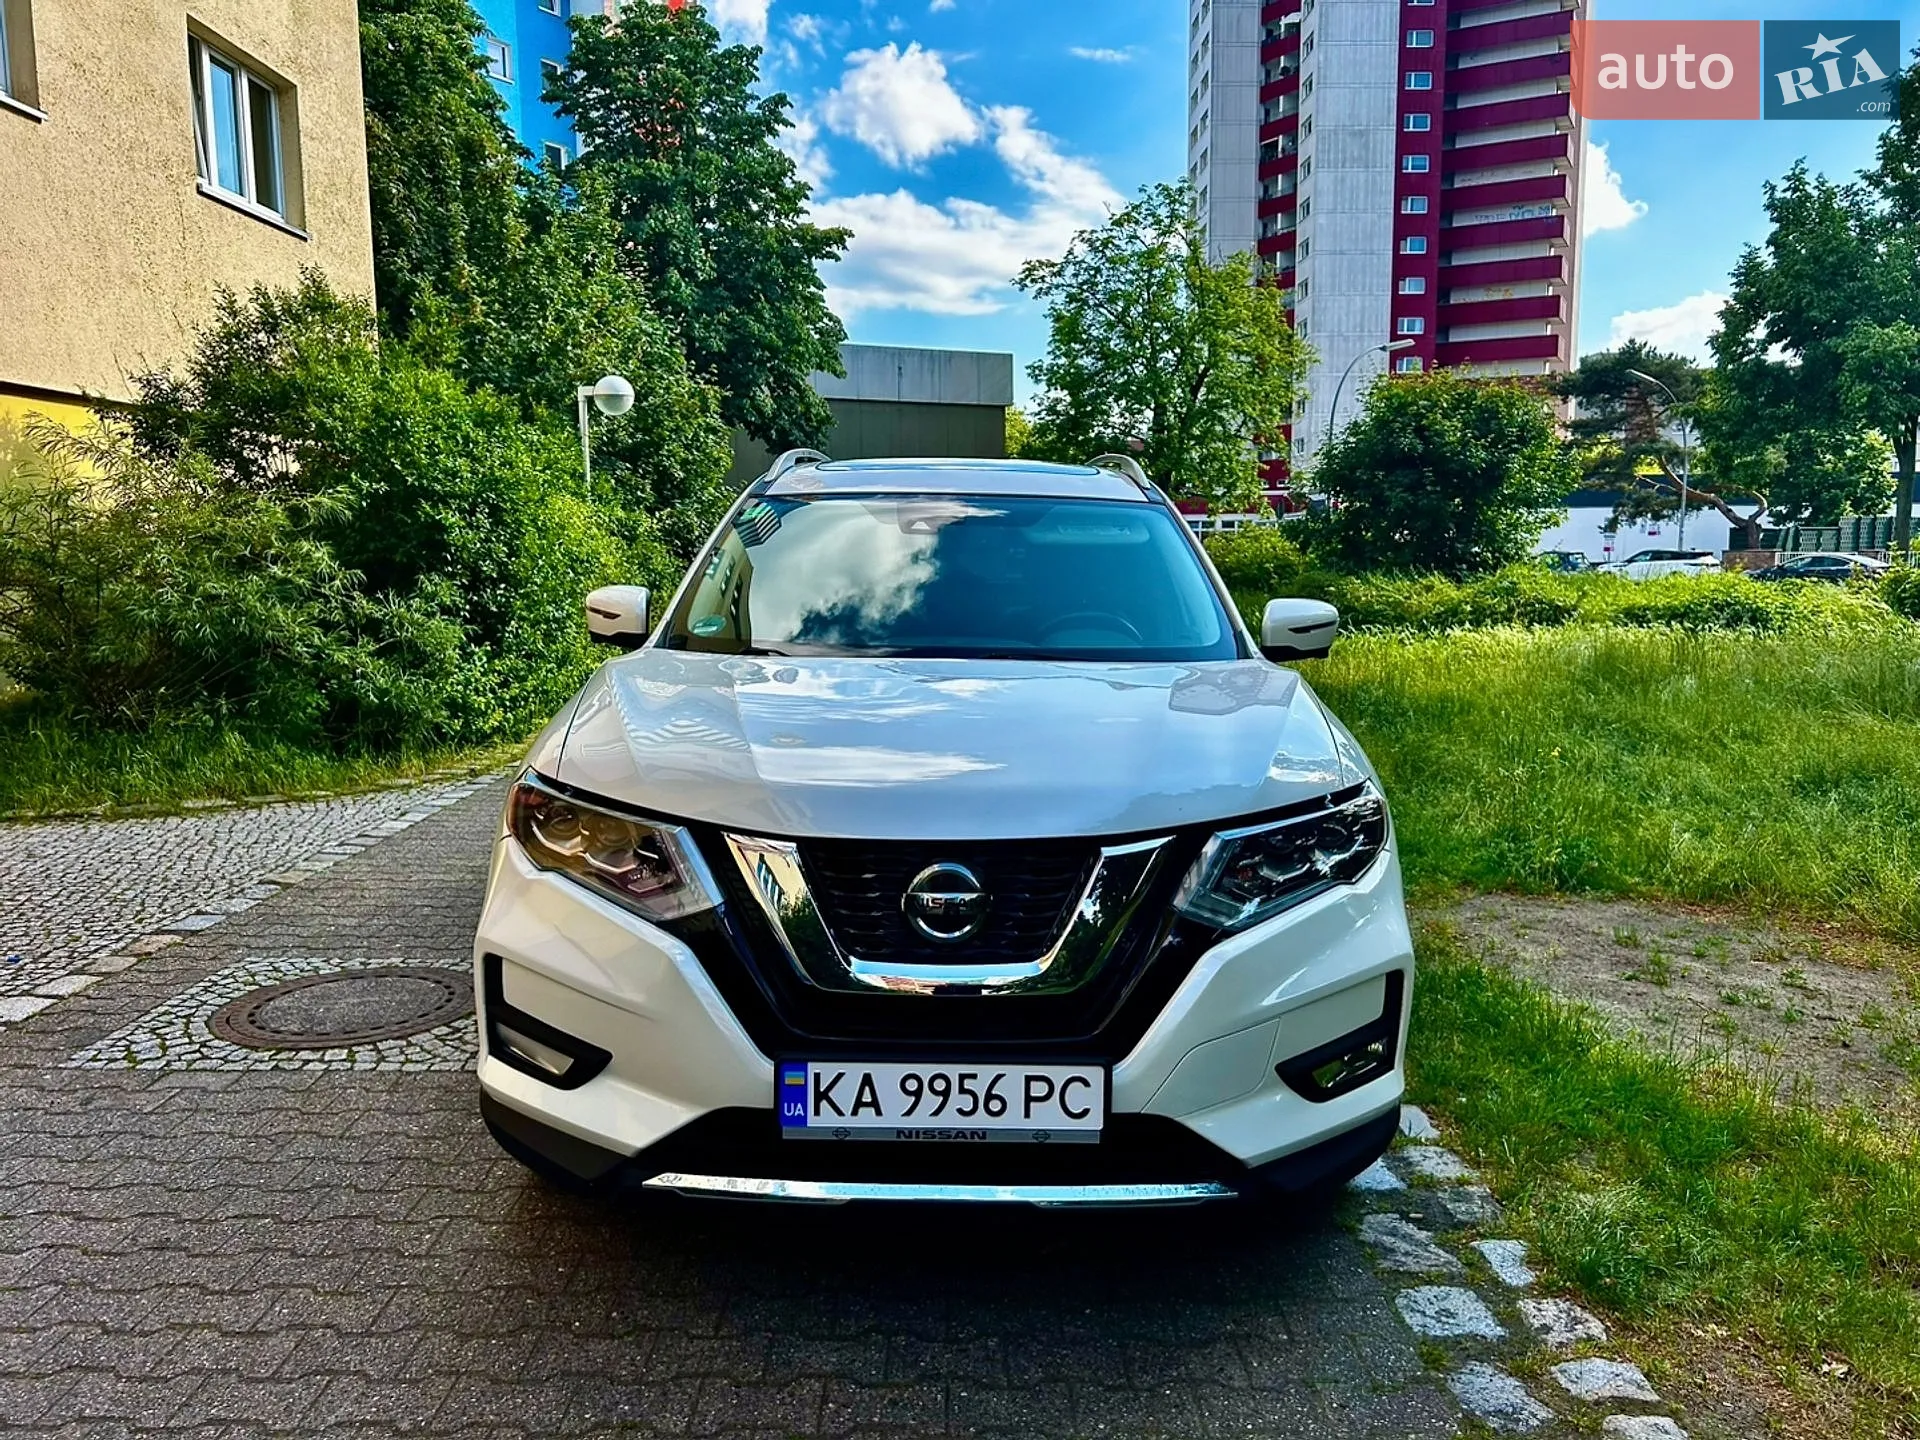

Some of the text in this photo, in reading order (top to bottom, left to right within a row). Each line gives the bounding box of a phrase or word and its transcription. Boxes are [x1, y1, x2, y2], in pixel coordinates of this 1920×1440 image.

[813, 1071, 1091, 1120] KA 9956 PC
[784, 1102, 805, 1117] UA
[895, 1128, 988, 1141] NISSAN
